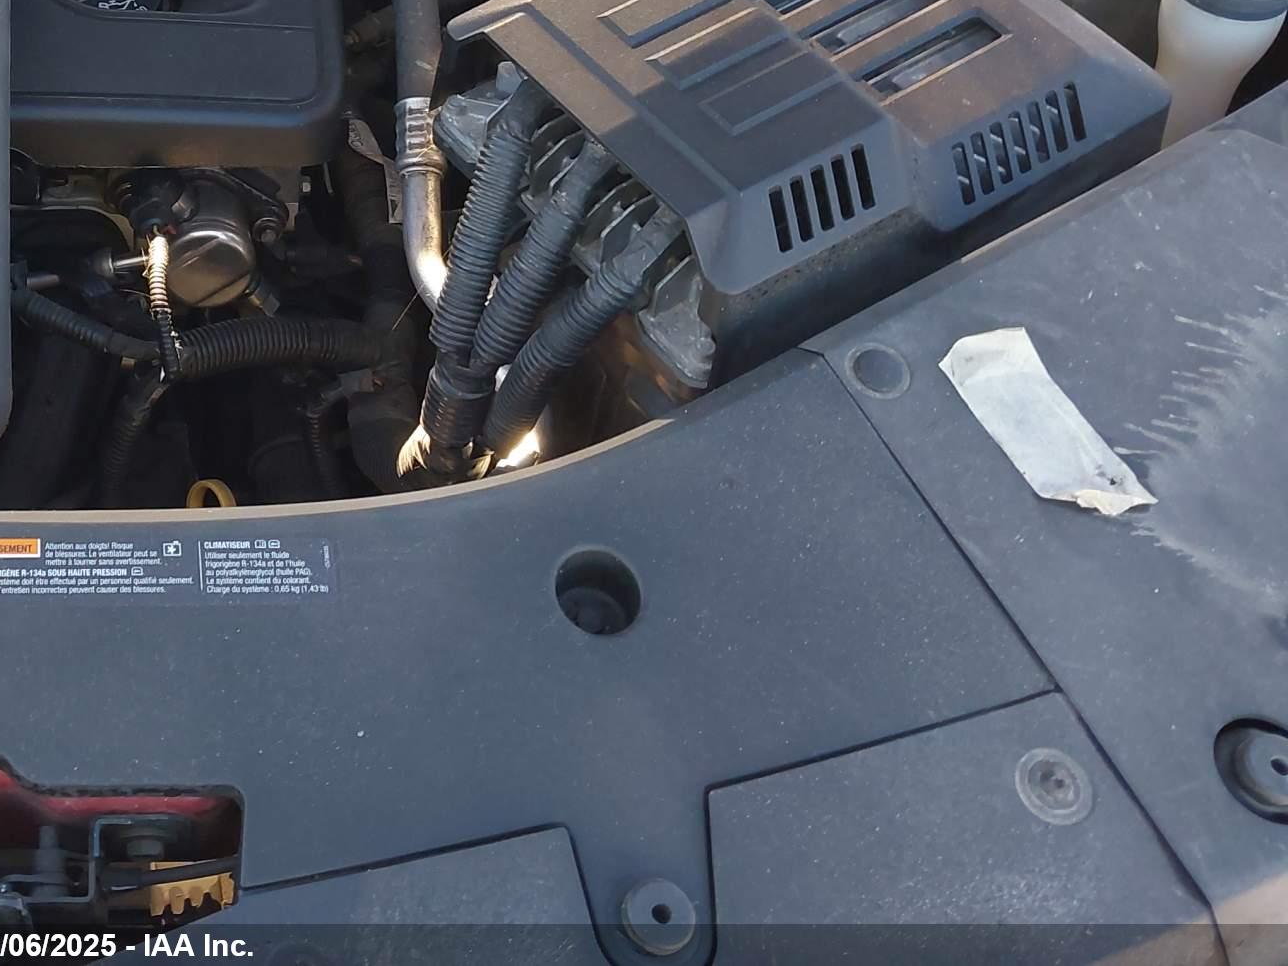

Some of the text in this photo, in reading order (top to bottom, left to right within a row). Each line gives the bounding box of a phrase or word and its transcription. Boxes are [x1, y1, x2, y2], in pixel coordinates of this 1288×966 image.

[204, 541, 251, 549] CLIMATISEUR
[21, 569, 46, 577] R-134a
[47, 568, 66, 576] SOUS
[68, 568, 90, 576] HAUTE
[92, 568, 127, 576] PRESSION
